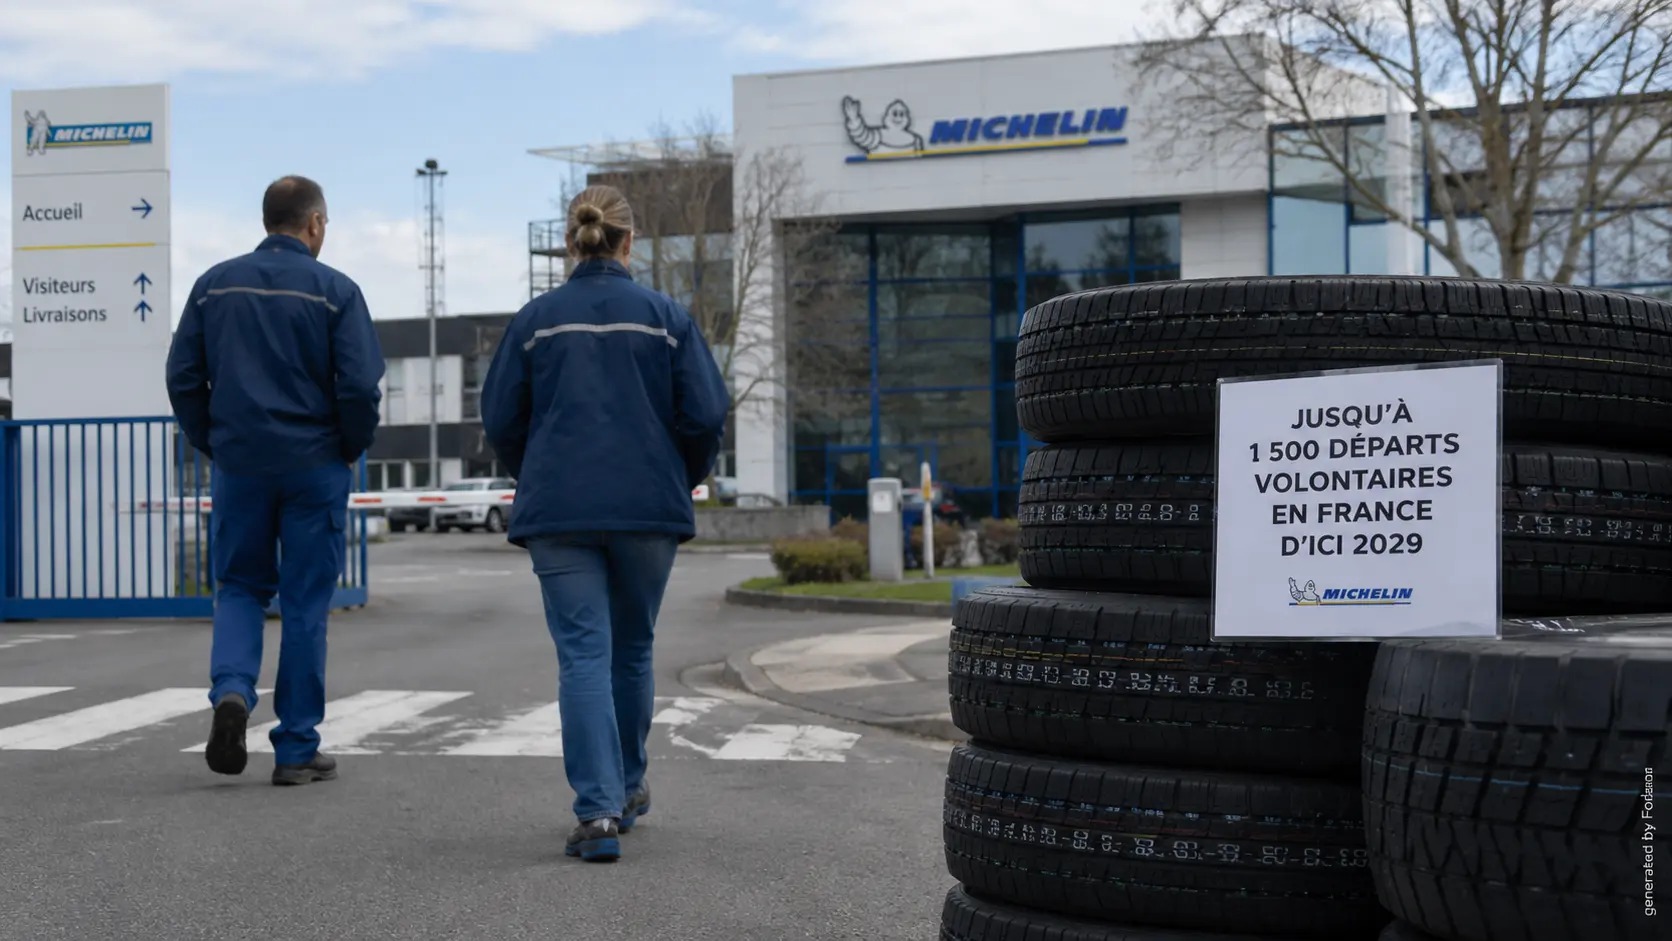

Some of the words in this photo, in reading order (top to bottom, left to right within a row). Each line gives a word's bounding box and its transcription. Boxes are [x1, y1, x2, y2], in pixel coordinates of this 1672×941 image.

[54, 125, 150, 142] MICHELIN
[929, 106, 1129, 144] MICHELIN
[22, 203, 83, 221] Accueil
[22, 277, 96, 295] Visiteurs
[23, 306, 107, 323] Livraisons
[1291, 398, 1413, 430] JUSQU’À
[1269, 440, 1320, 462] 500
[1329, 433, 1460, 459] DÉPARTS
[1254, 466, 1453, 494] VOLONTAIRES
[1272, 504, 1307, 525] EN
[1318, 499, 1433, 524] FRANCE
[1281, 535, 1343, 556] D’ICI
[1353, 533, 1423, 555] 2029
[1322, 588, 1413, 600] MICHELIN
